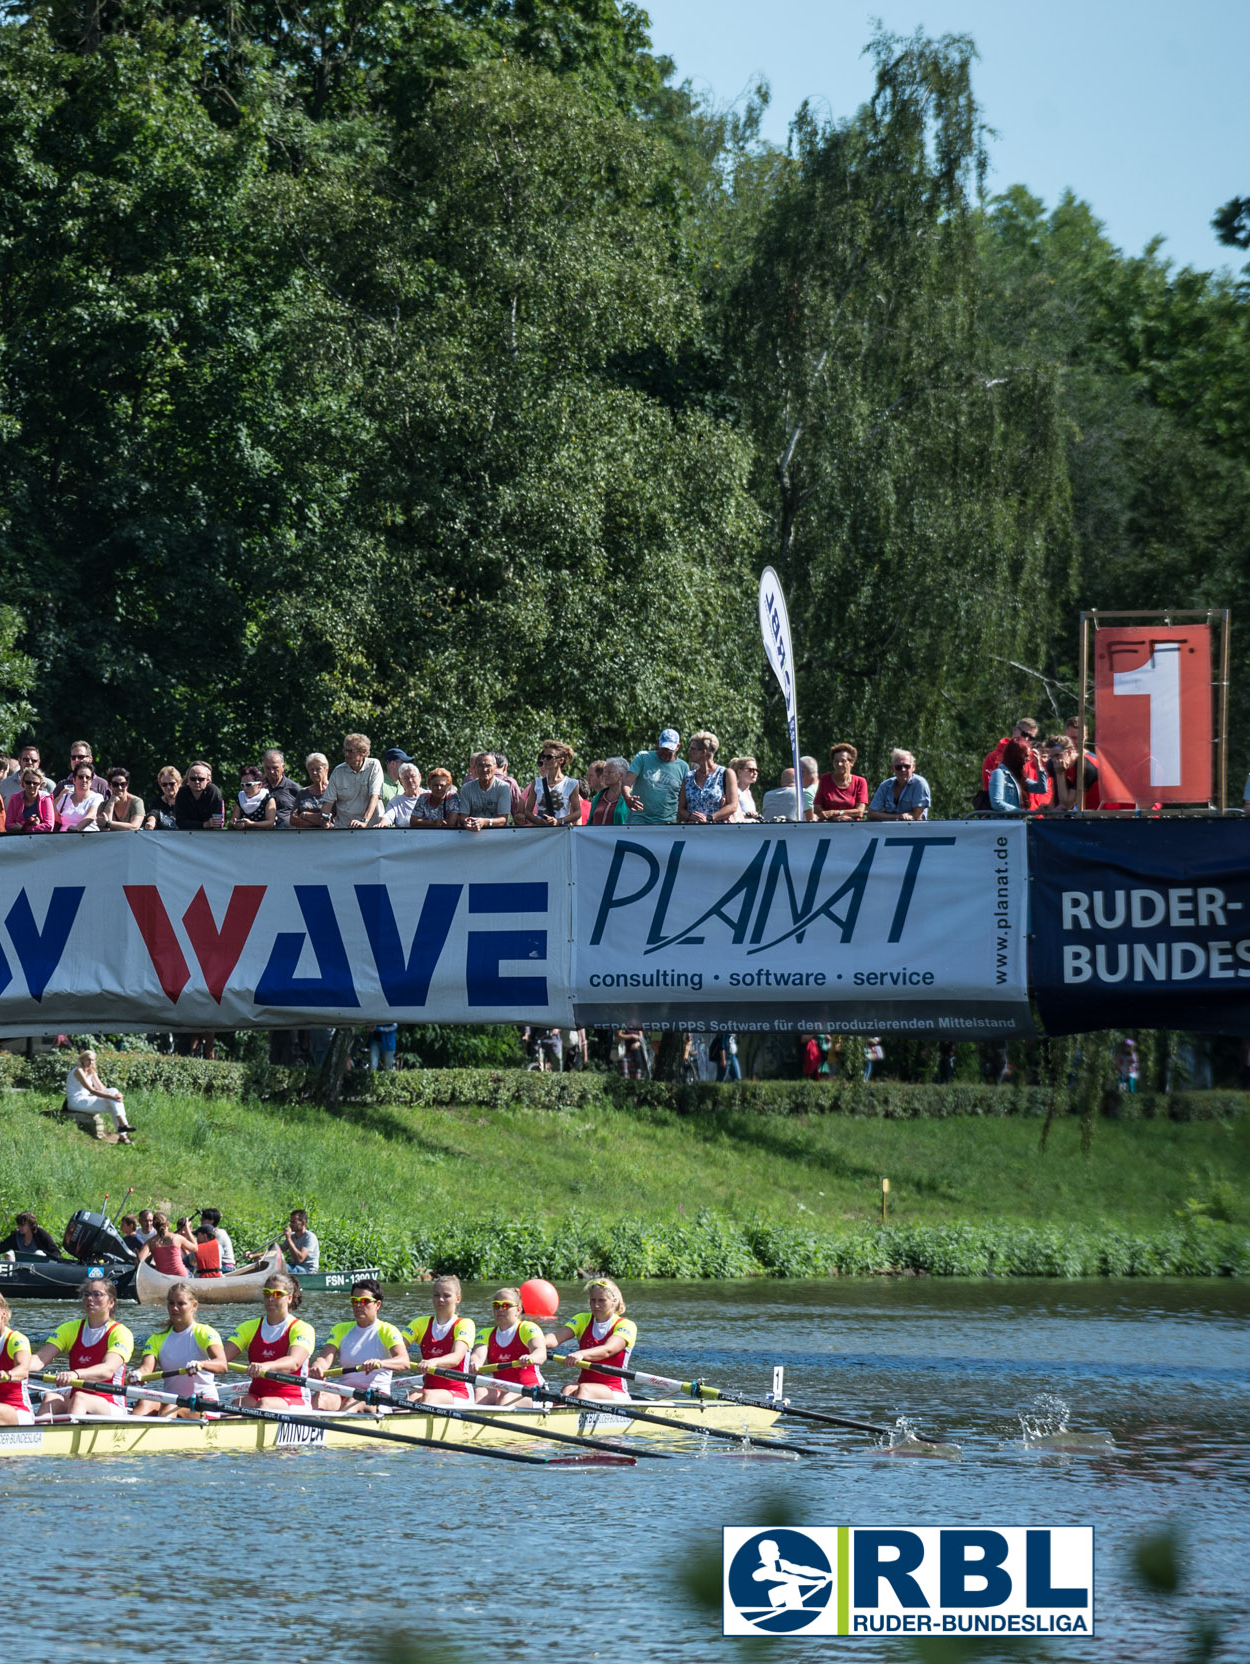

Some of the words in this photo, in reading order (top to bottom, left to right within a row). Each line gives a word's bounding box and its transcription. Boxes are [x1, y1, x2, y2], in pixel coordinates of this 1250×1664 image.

[1113, 643, 1181, 787] 1
[122, 881, 549, 1008] WAVE
[589, 836, 957, 956] PLANAT
[993, 836, 1013, 986] www.planat.de
[1061, 886, 1243, 931] RUDER-
[589, 968, 704, 991] consulting
[728, 968, 827, 987] software
[853, 967, 936, 986] service
[710, 1020, 770, 1032] Software
[774, 1018, 793, 1031] für
[797, 1019, 822, 1031] den
[827, 1017, 934, 1032] produzierenden
[938, 1017, 1016, 1029] Mittelstand
